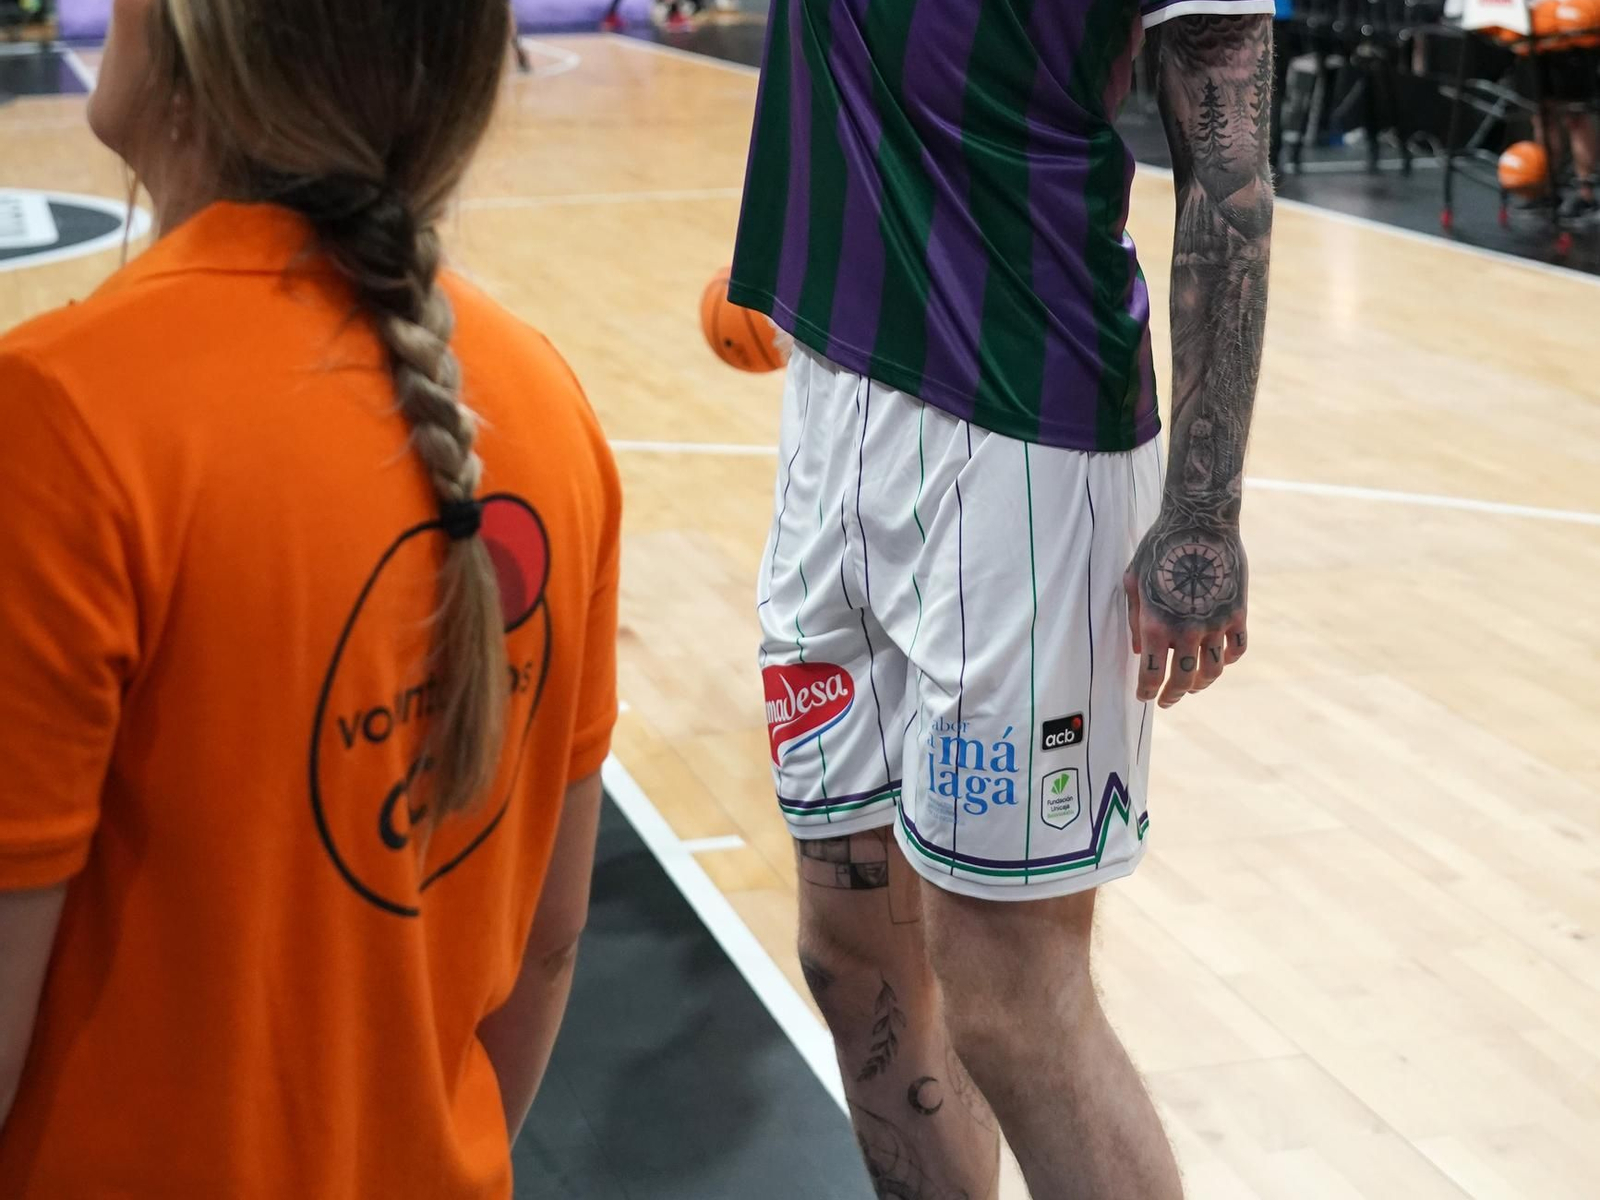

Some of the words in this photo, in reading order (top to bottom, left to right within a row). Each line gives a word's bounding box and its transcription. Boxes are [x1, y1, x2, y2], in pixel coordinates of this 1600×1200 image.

[938, 725, 1020, 773] má
[1045, 728, 1075, 747] acb
[928, 752, 1020, 816] laga
